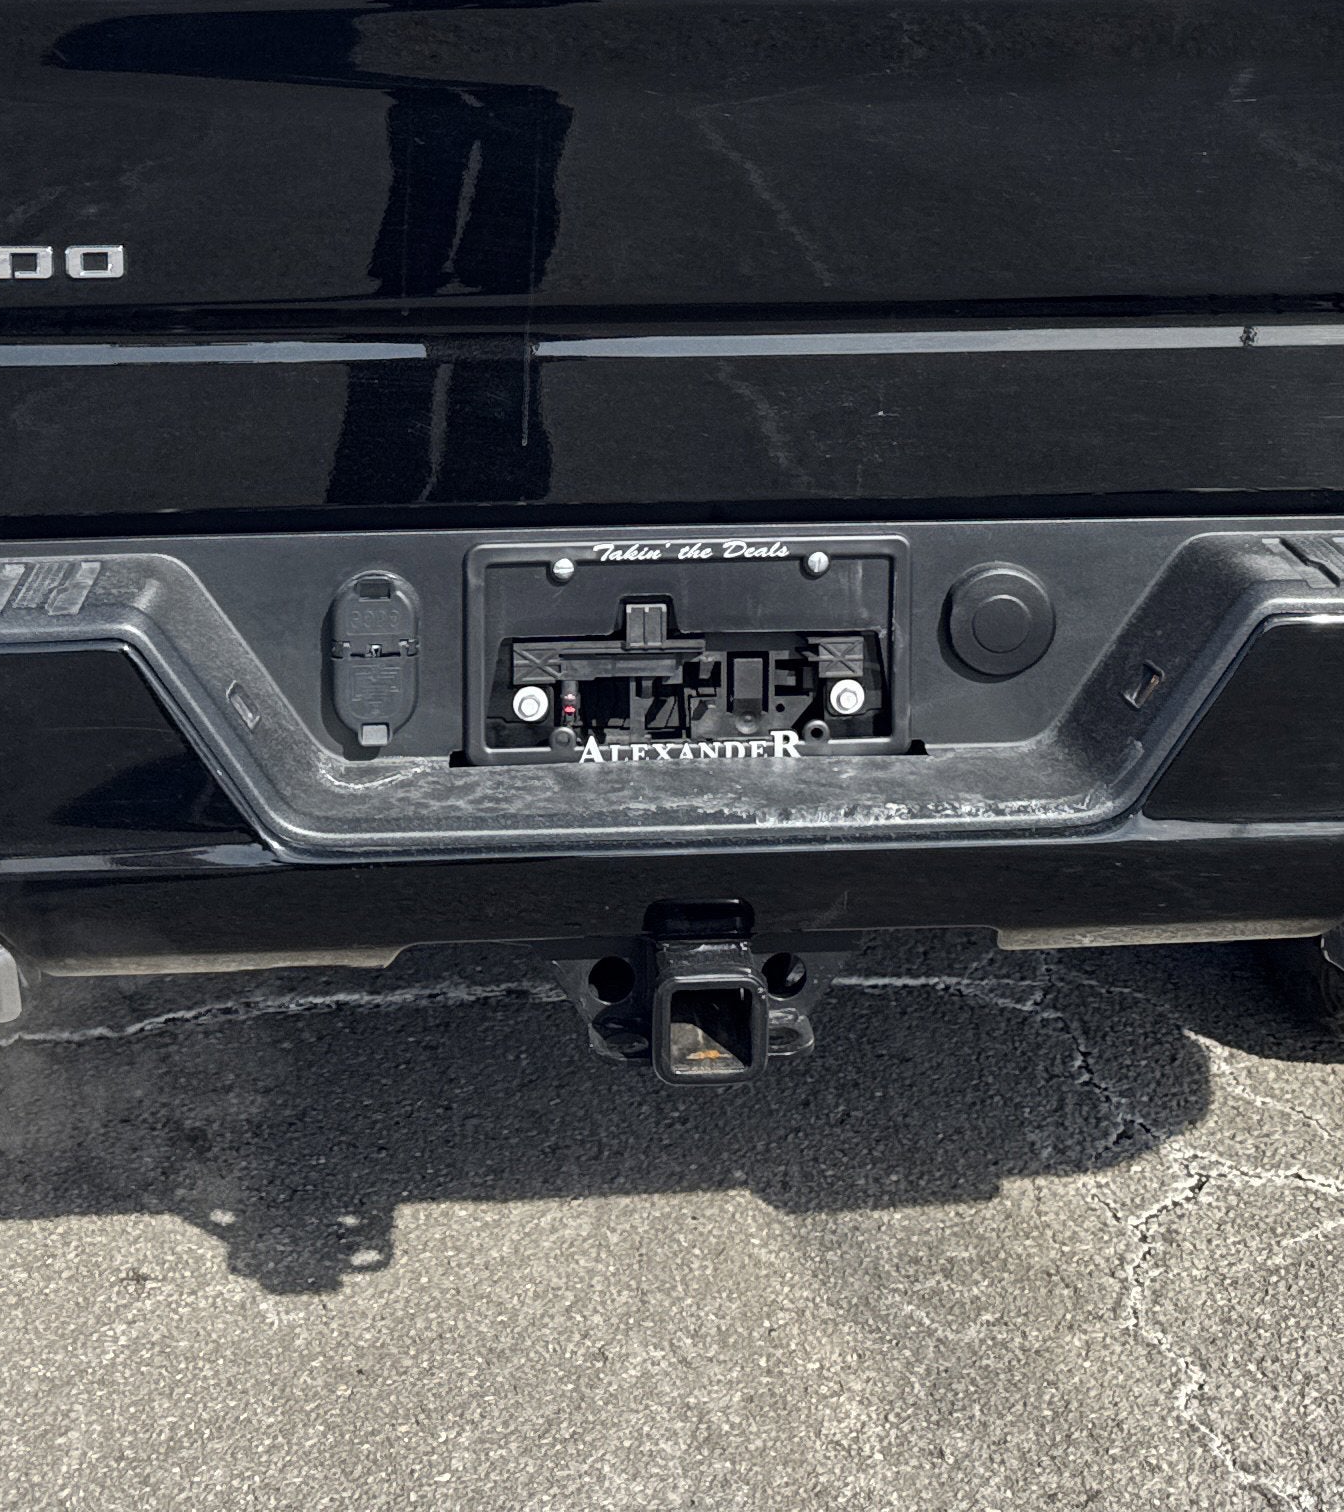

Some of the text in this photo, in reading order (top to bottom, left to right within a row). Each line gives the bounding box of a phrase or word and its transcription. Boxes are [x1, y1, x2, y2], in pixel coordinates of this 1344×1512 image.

[592, 540, 790, 562] Takin' the Deals
